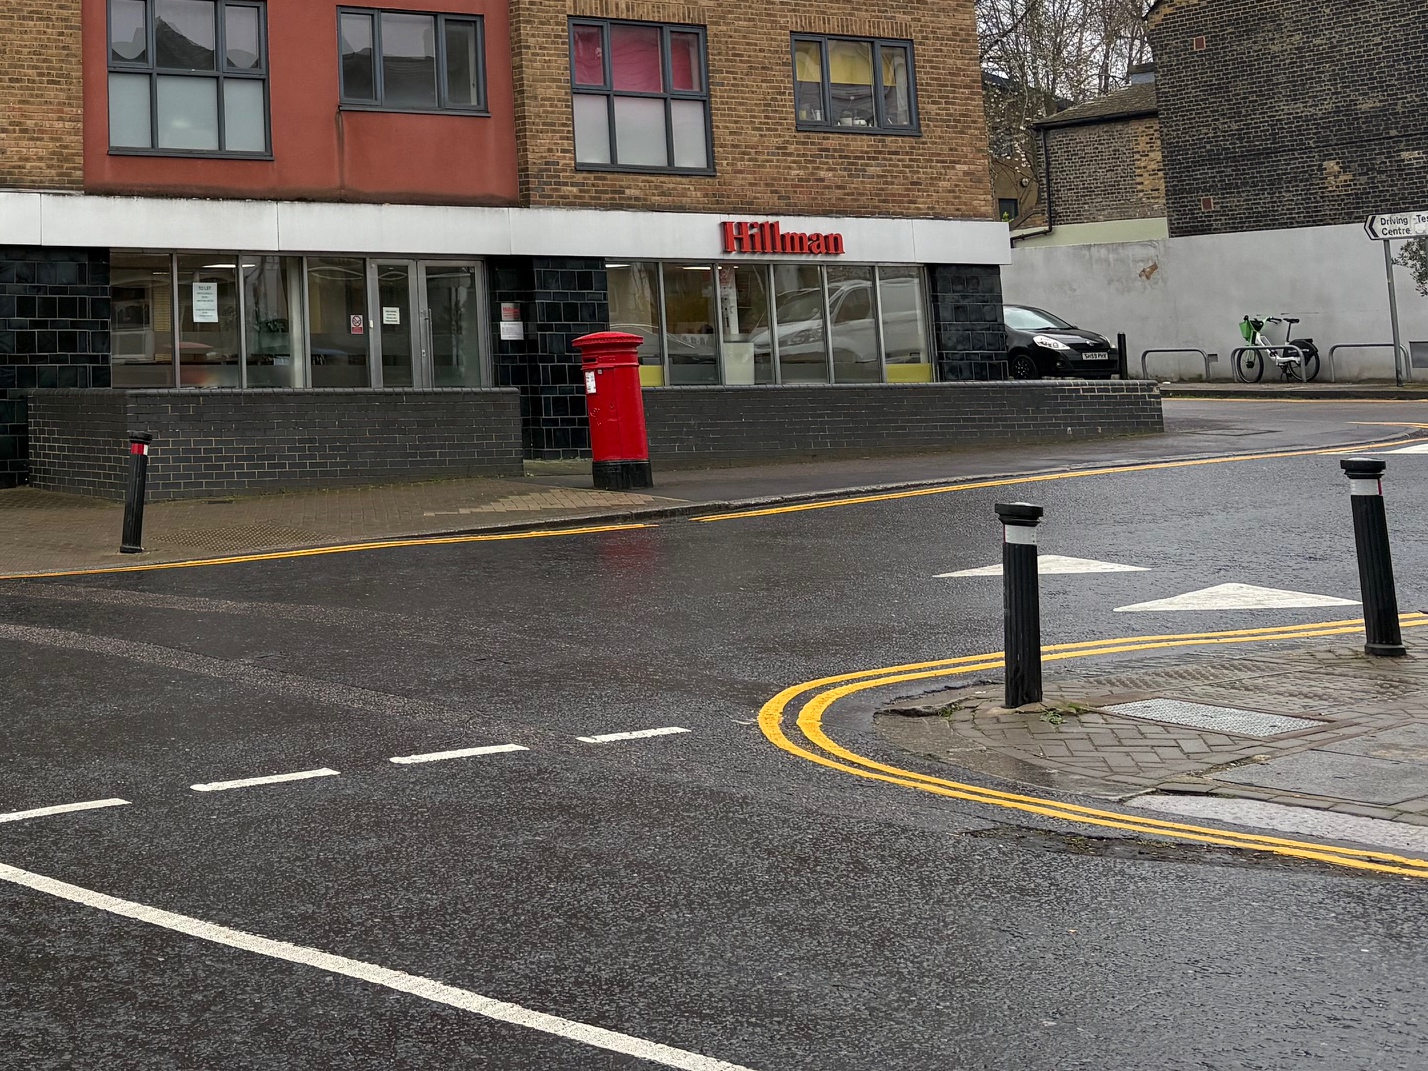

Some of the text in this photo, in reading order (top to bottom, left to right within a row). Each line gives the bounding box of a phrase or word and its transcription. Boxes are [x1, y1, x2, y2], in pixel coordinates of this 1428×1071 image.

[1380, 216, 1409, 226] Driving
[1381, 227, 1411, 236] Centre
[721, 220, 845, 254] Hillman
